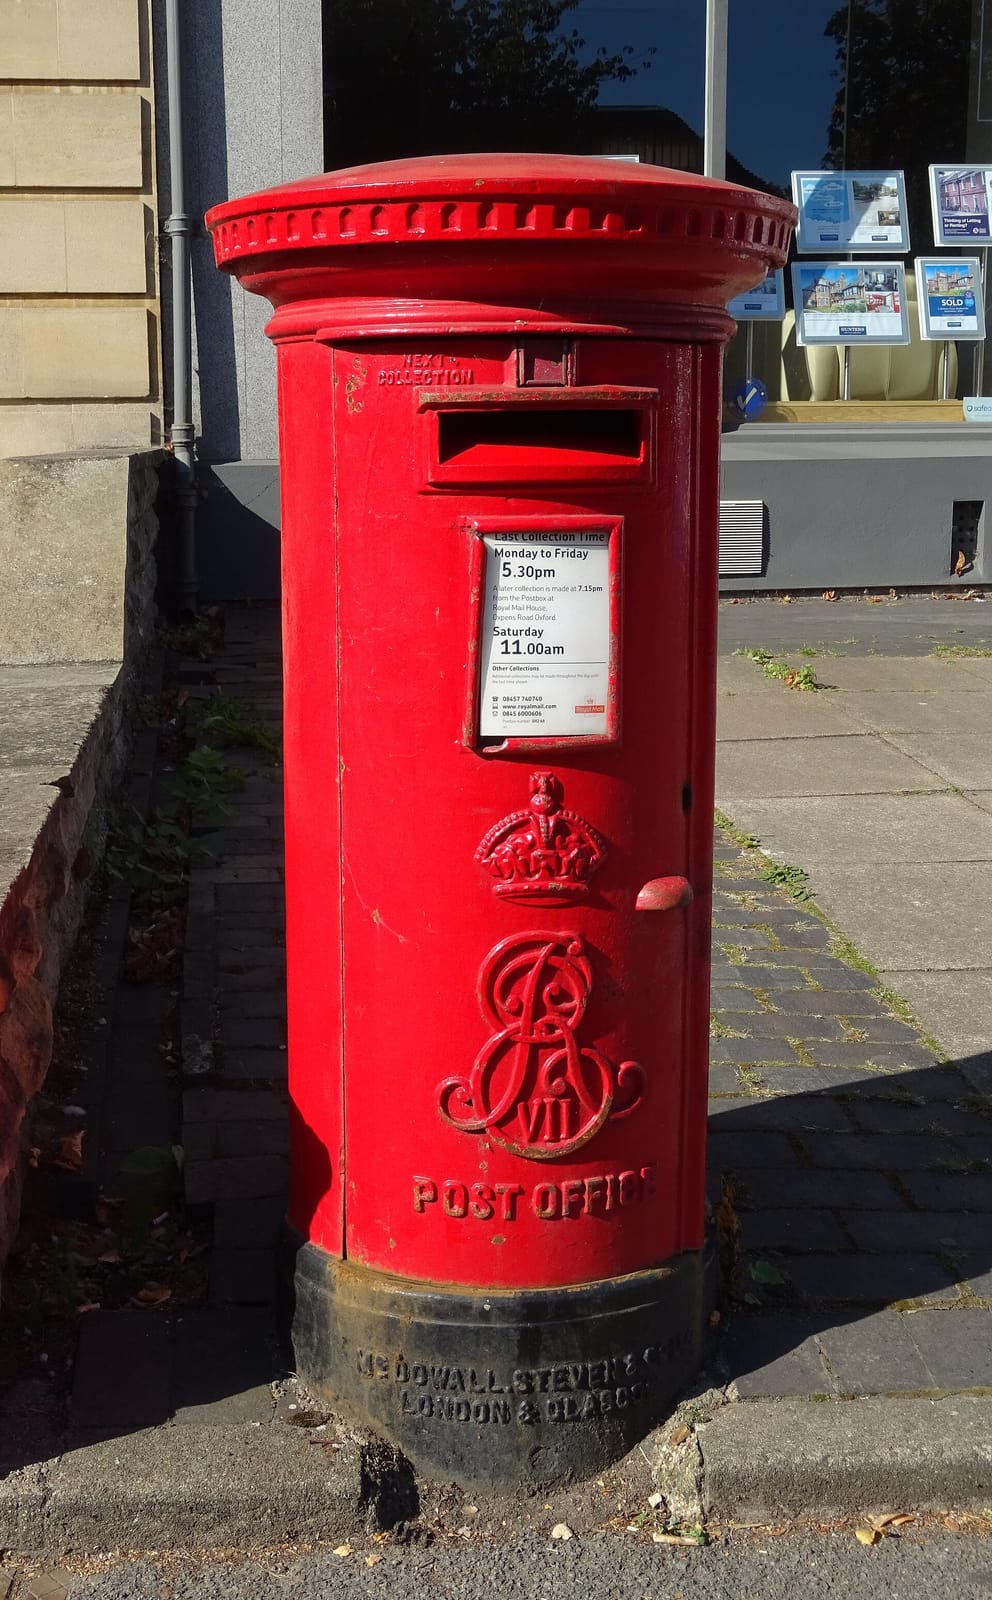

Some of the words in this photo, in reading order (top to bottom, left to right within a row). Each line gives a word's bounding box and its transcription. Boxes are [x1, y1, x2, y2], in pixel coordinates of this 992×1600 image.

[402, 354, 446, 369] NEXT
[378, 370, 475, 386] COLLECTION
[494, 532, 518, 542] Last
[521, 532, 576, 542] Collection
[579, 532, 605, 542] Time
[494, 548, 539, 560] Monday
[541, 549, 552, 558] to
[554, 548, 589, 560] Friday
[502, 562, 556, 580] 5.30pm
[578, 585, 603, 593] 7.15pm
[492, 604, 510, 612] Royal
[492, 626, 544, 638] Saturday
[500, 639, 565, 656] 11.00am
[517, 1097, 572, 1142] VII
[412, 1175, 522, 1221] POST
[532, 1166, 654, 1218] OFFIC
[401, 1389, 512, 1425] LONDON
[518, 1399, 542, 1426] &
